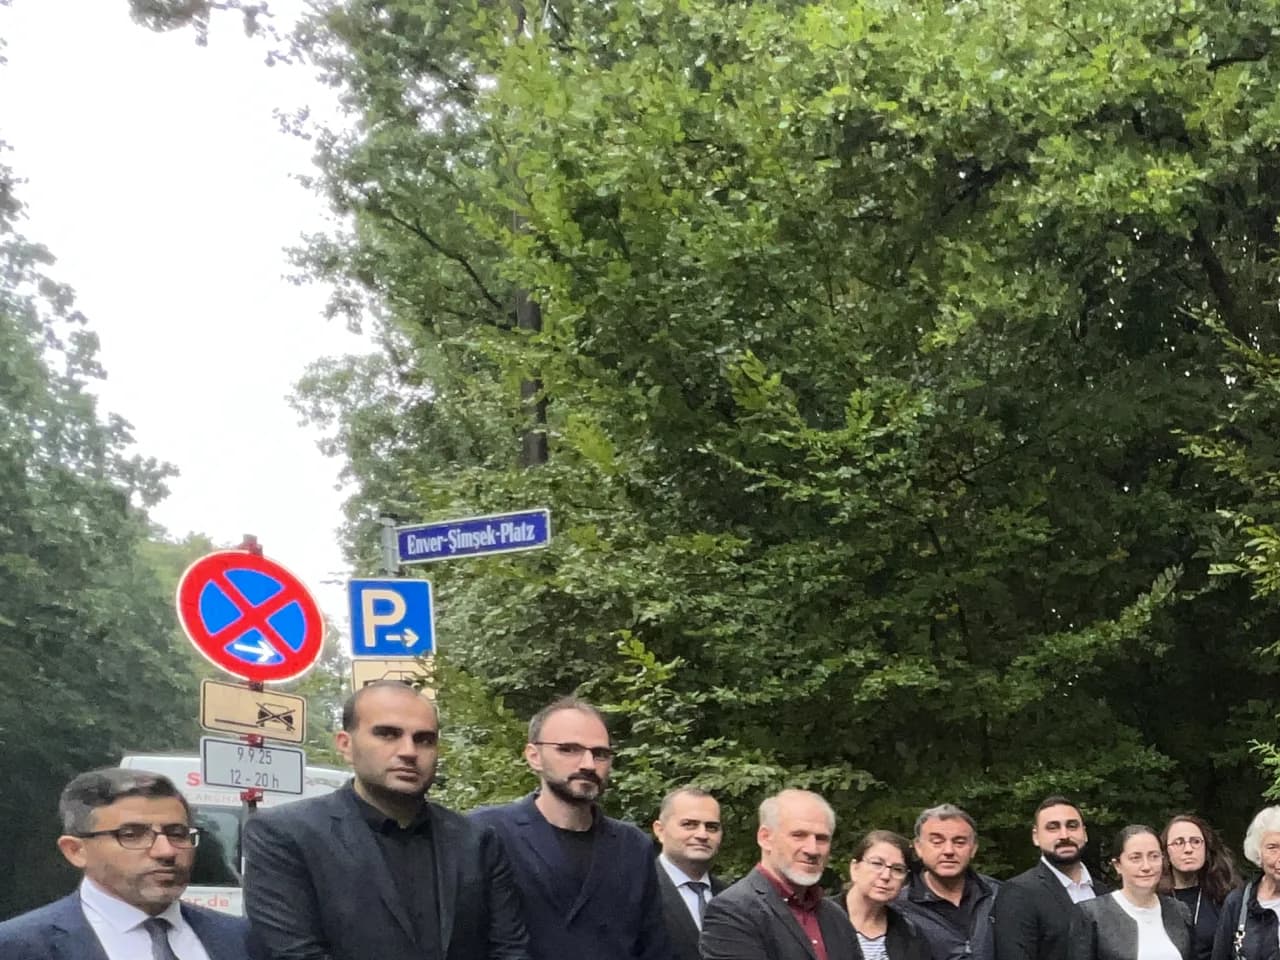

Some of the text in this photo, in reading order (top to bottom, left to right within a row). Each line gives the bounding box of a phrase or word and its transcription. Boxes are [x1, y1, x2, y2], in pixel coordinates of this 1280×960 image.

[407, 521, 536, 554] Enver-Şimşek-Platz
[361, 588, 407, 648] P
[230, 768, 242, 785] 12
[255, 772, 269, 788] 20
[272, 774, 280, 789] h
